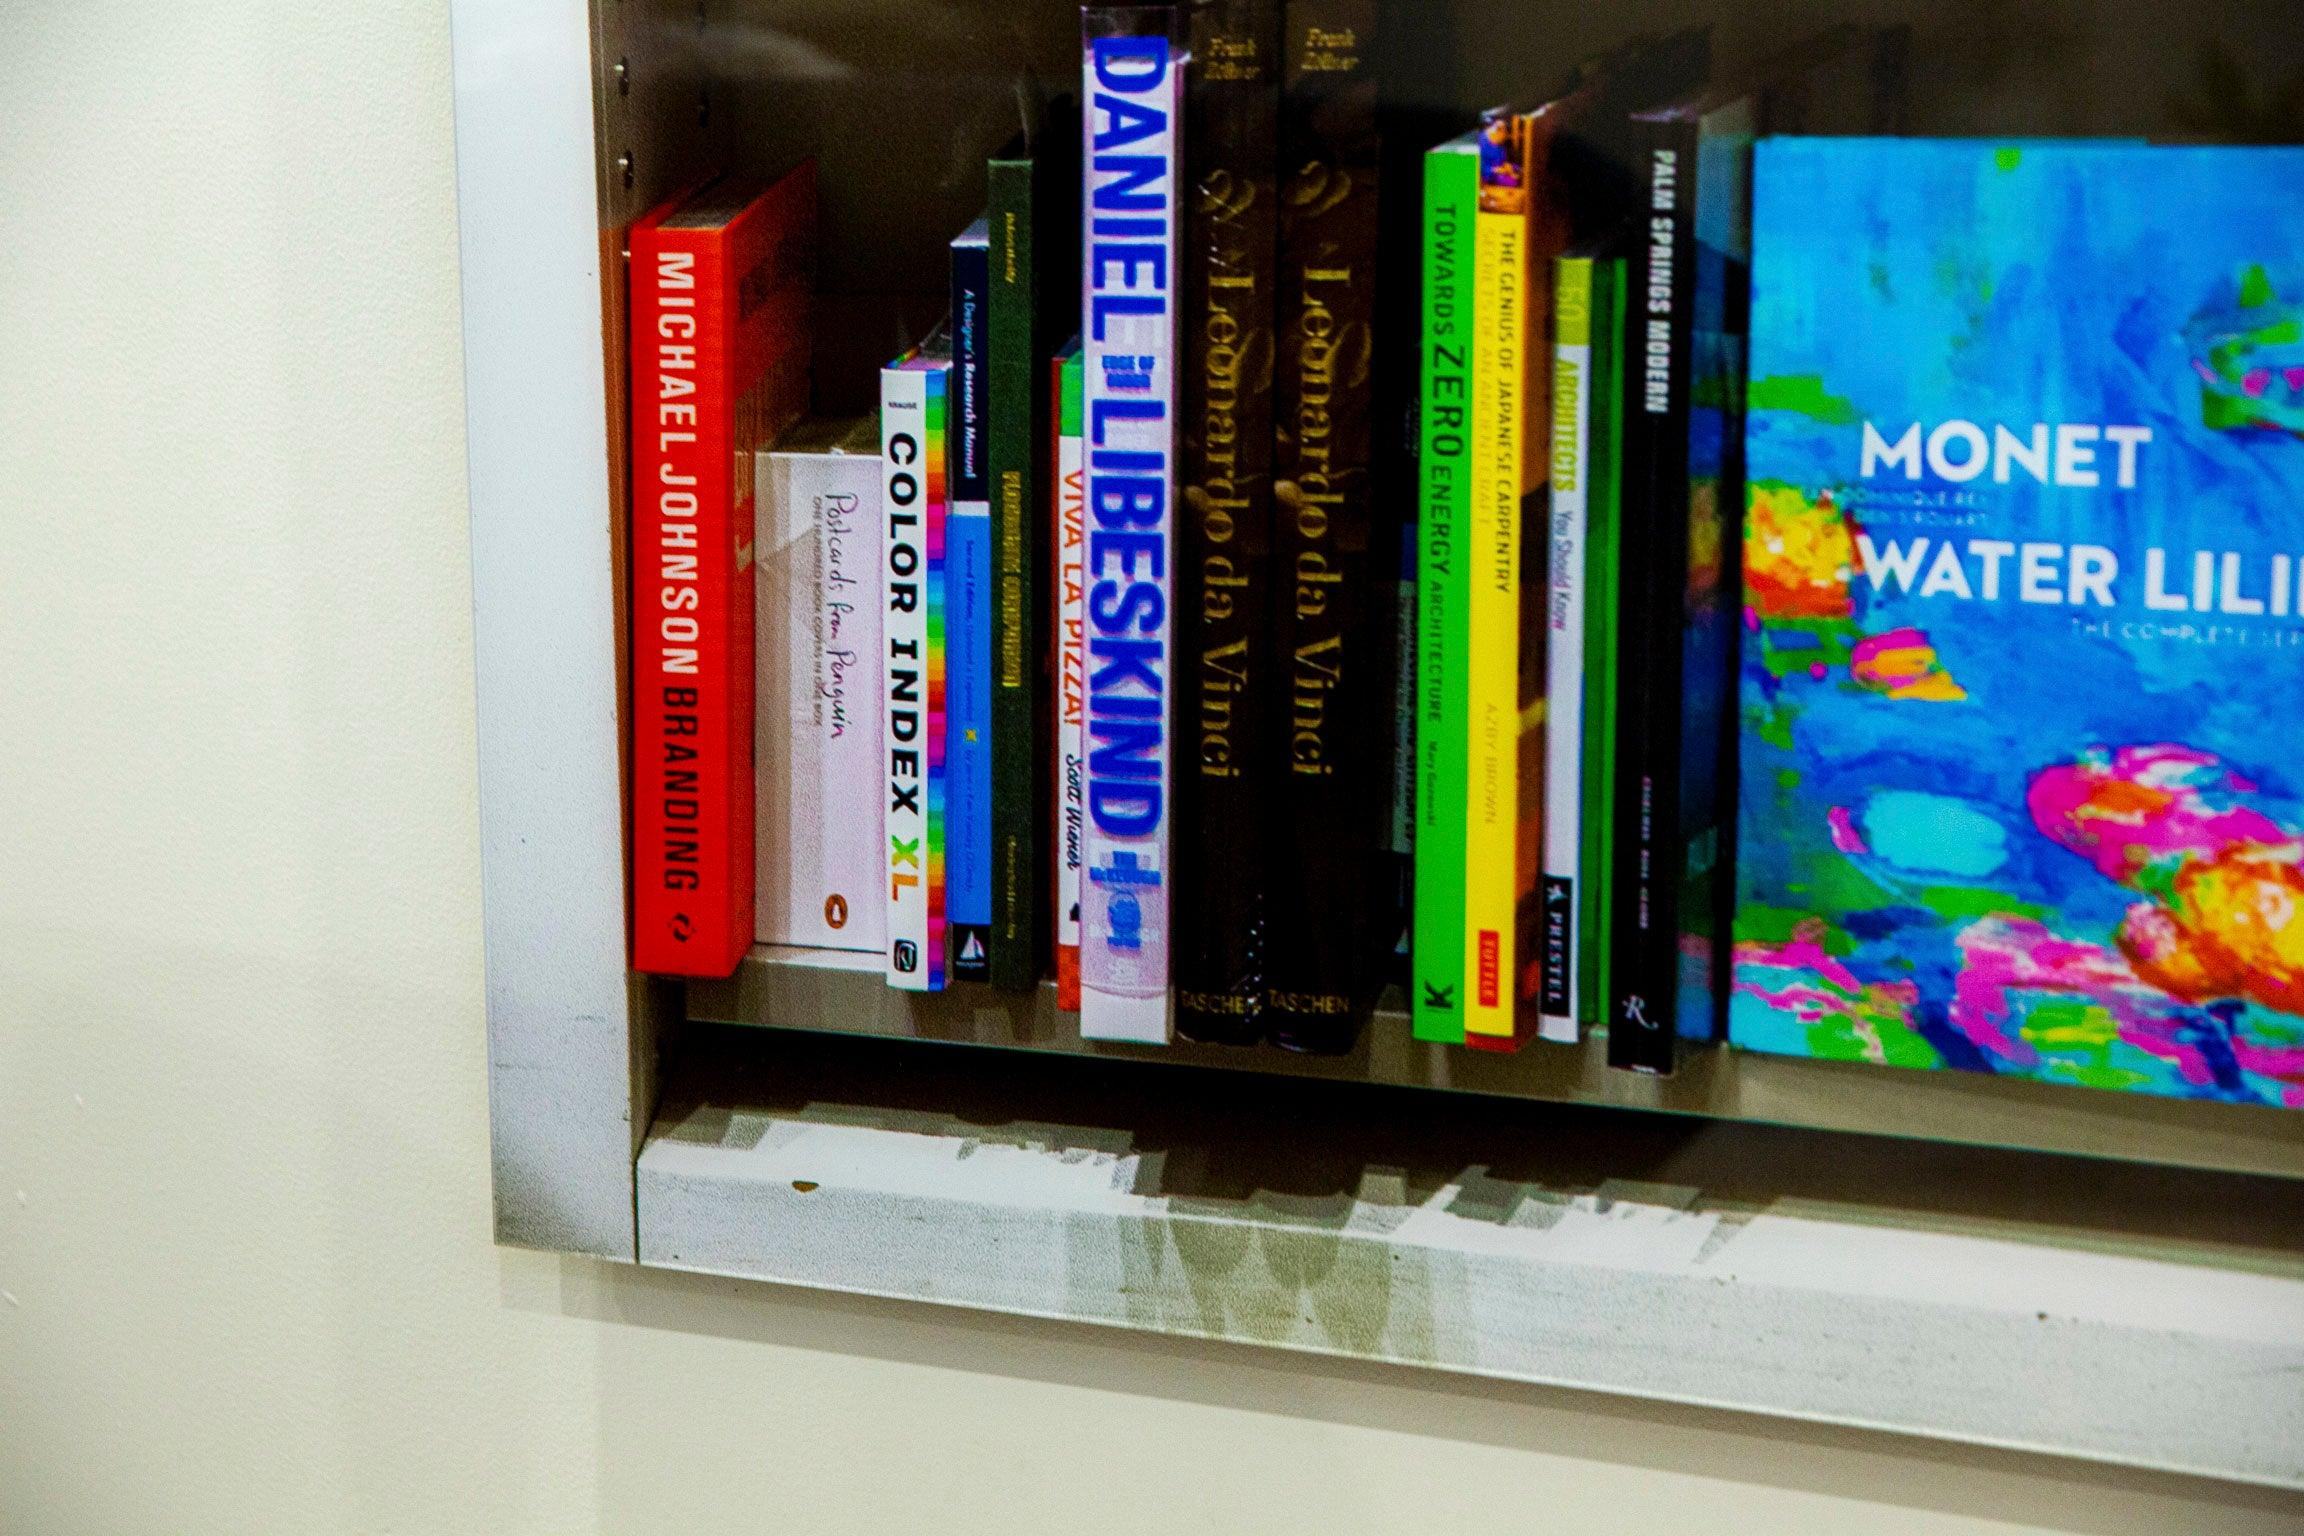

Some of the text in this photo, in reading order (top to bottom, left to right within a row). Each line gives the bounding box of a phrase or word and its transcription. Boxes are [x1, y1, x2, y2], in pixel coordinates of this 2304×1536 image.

[961, 302, 976, 359] Designer's
[1645, 150, 1677, 413] PALM SPRINGS MODERN
[964, 362, 977, 423] Research
[1089, 36, 1169, 837] DANIEL LIBESKIND
[1495, 231, 1517, 592] THE GENIUS OF JAPANESE CARPENTRY
[1553, 360, 1580, 492] ARCHITECTS
[963, 427, 977, 479] Manual
[1427, 204, 1466, 723] TOWARDS ZERO ENERGY ARCHITECTURE
[1860, 419, 2153, 488] MONET
[1063, 470, 1084, 549] VIVA
[1201, 272, 1256, 779] Leonardo da Vinci
[1293, 264, 1354, 775] Leonardo da Vinci
[658, 252, 700, 890] MICHAEL JOHNSON BRANDING
[820, 493, 859, 741] Postcards from Penguin
[1063, 563, 1083, 606] LA
[1856, 534, 2304, 618] WATER LILI
[888, 432, 919, 902] COLOR INDEX XL
[1063, 619, 1083, 727] PIZZA!
[1425, 741, 1439, 769] Mary
[1483, 704, 1500, 824] AZBY BROWN
[1267, 988, 1350, 1014] TASCHEN
[1482, 939, 1496, 998] TUTTLE
[1547, 911, 1564, 1003] PRESTEL
